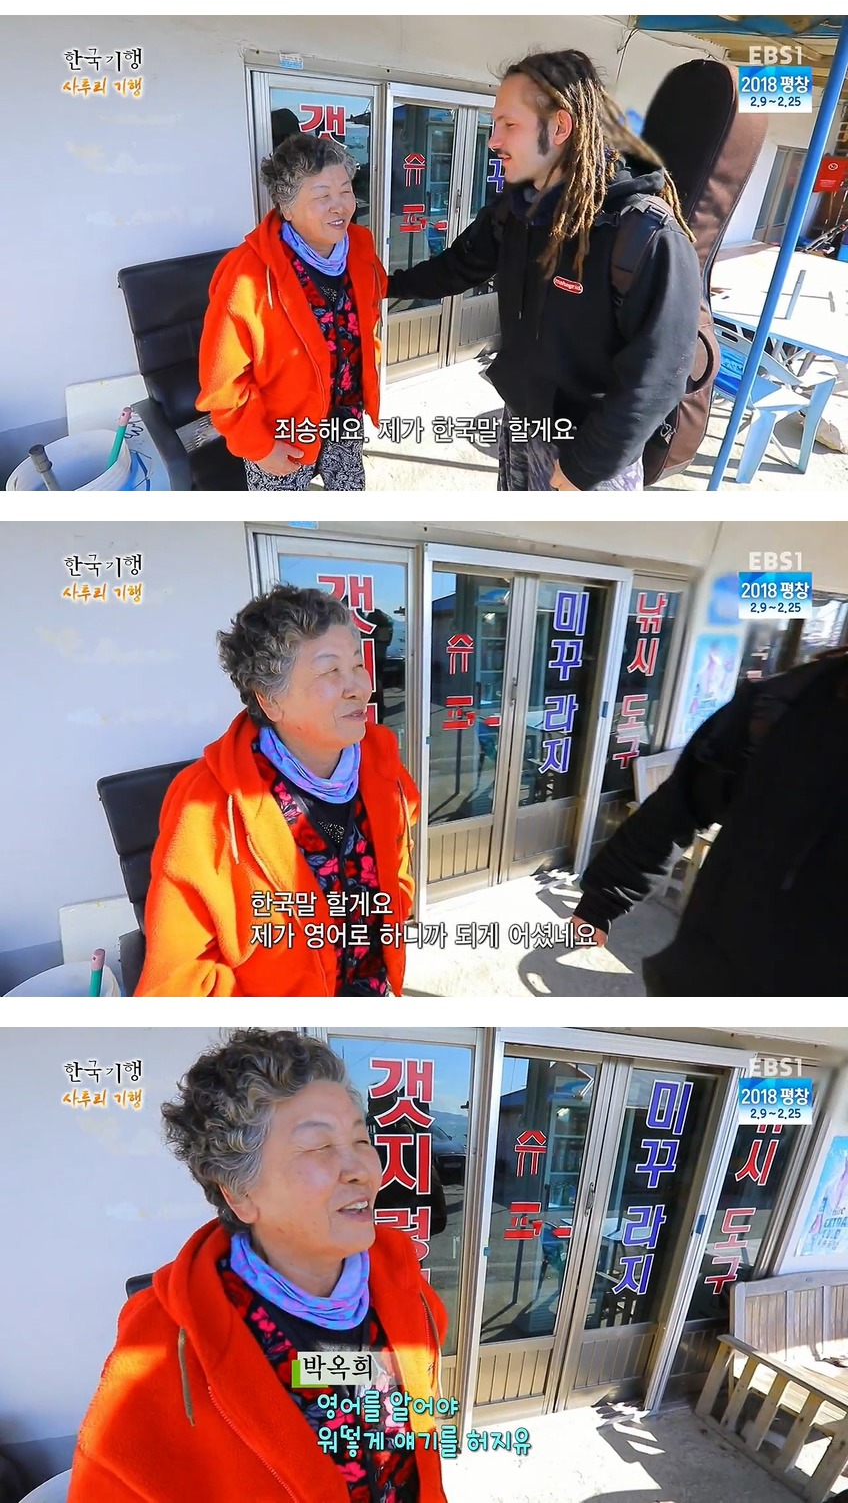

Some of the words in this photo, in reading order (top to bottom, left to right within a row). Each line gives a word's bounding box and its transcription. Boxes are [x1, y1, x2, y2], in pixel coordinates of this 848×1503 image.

[626, 592, 668, 677] 낚시
[612, 693, 649, 770] 도구
[703, 1207, 757, 1295] 도구
